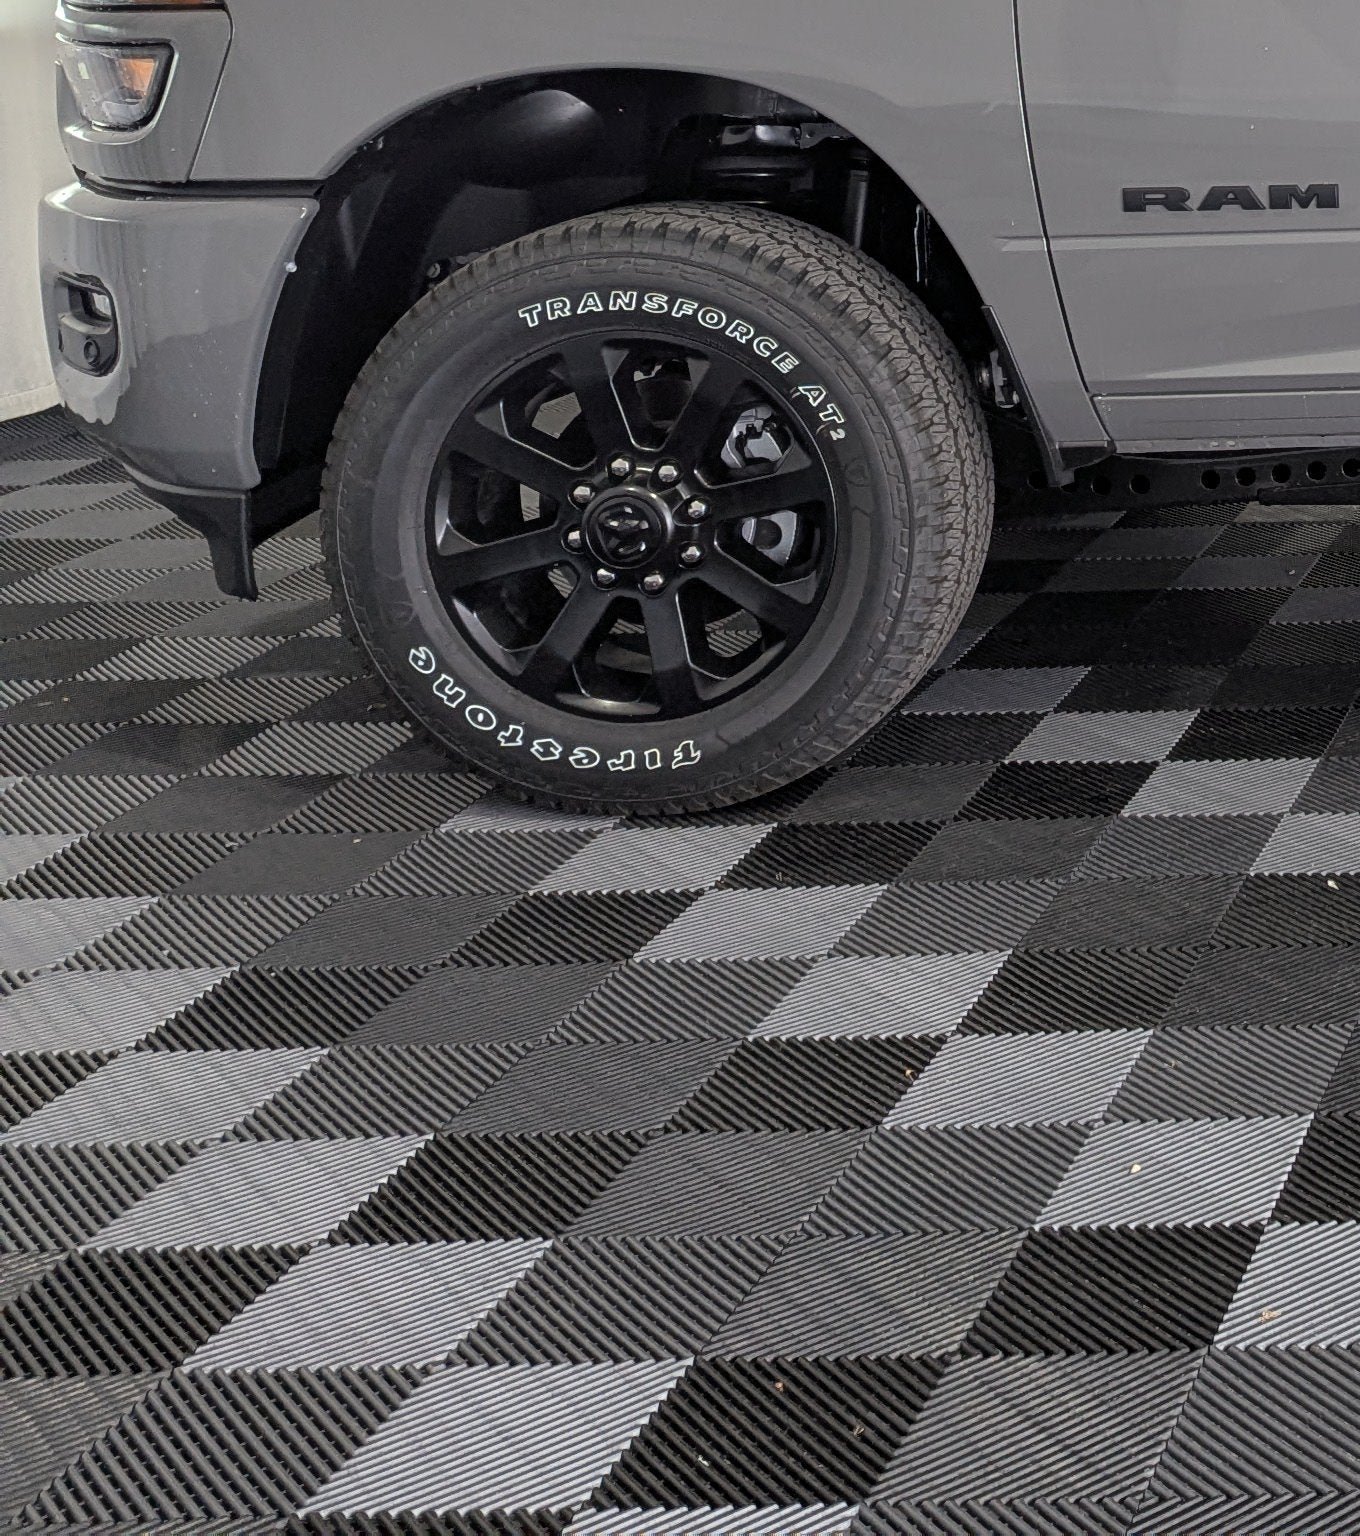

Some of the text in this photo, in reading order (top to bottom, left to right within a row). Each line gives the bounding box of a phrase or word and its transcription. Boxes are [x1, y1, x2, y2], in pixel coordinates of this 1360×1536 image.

[1122, 183, 1340, 213] RAM
[518, 290, 800, 376] TRANSFORCE
[408, 646, 702, 771] Firestone
